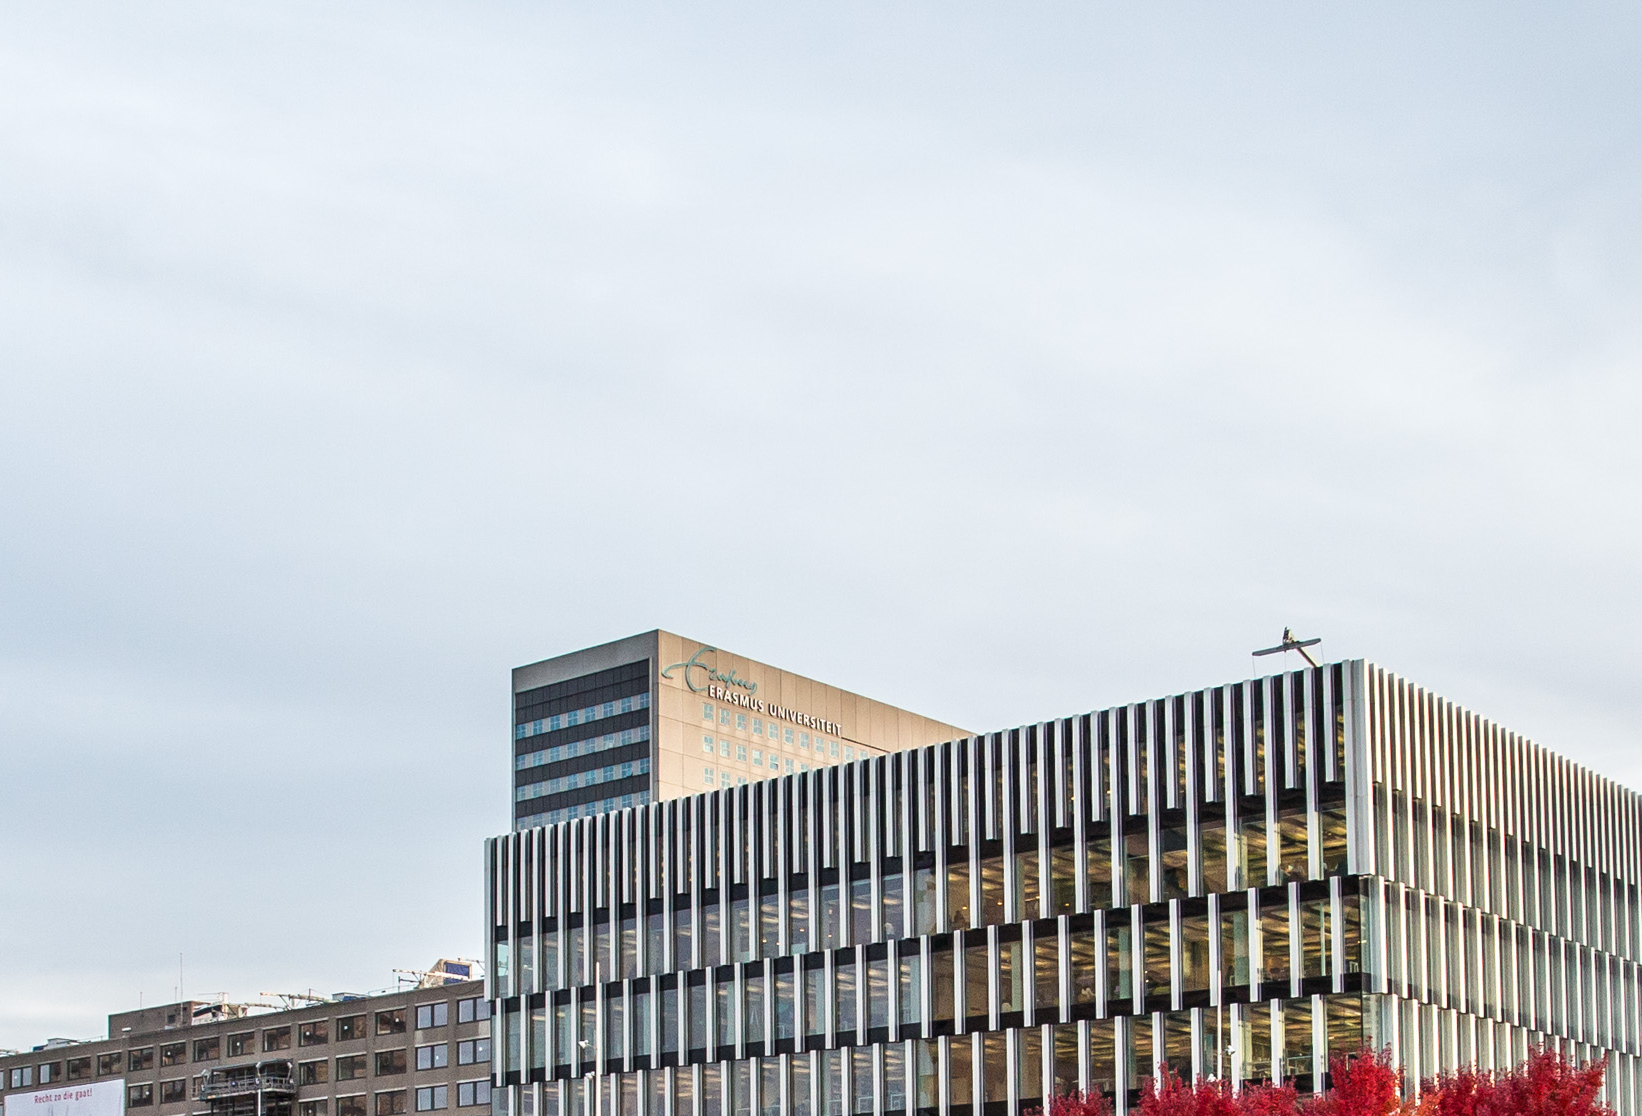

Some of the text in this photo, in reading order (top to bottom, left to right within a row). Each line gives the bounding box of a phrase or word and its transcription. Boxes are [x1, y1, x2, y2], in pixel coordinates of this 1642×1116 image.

[709, 685, 842, 736] ERASMUS UNIVERSITEIT
[34, 1094, 53, 1104] Recht
[63, 1091, 73, 1100] die
[75, 1088, 93, 1101] gaat!
